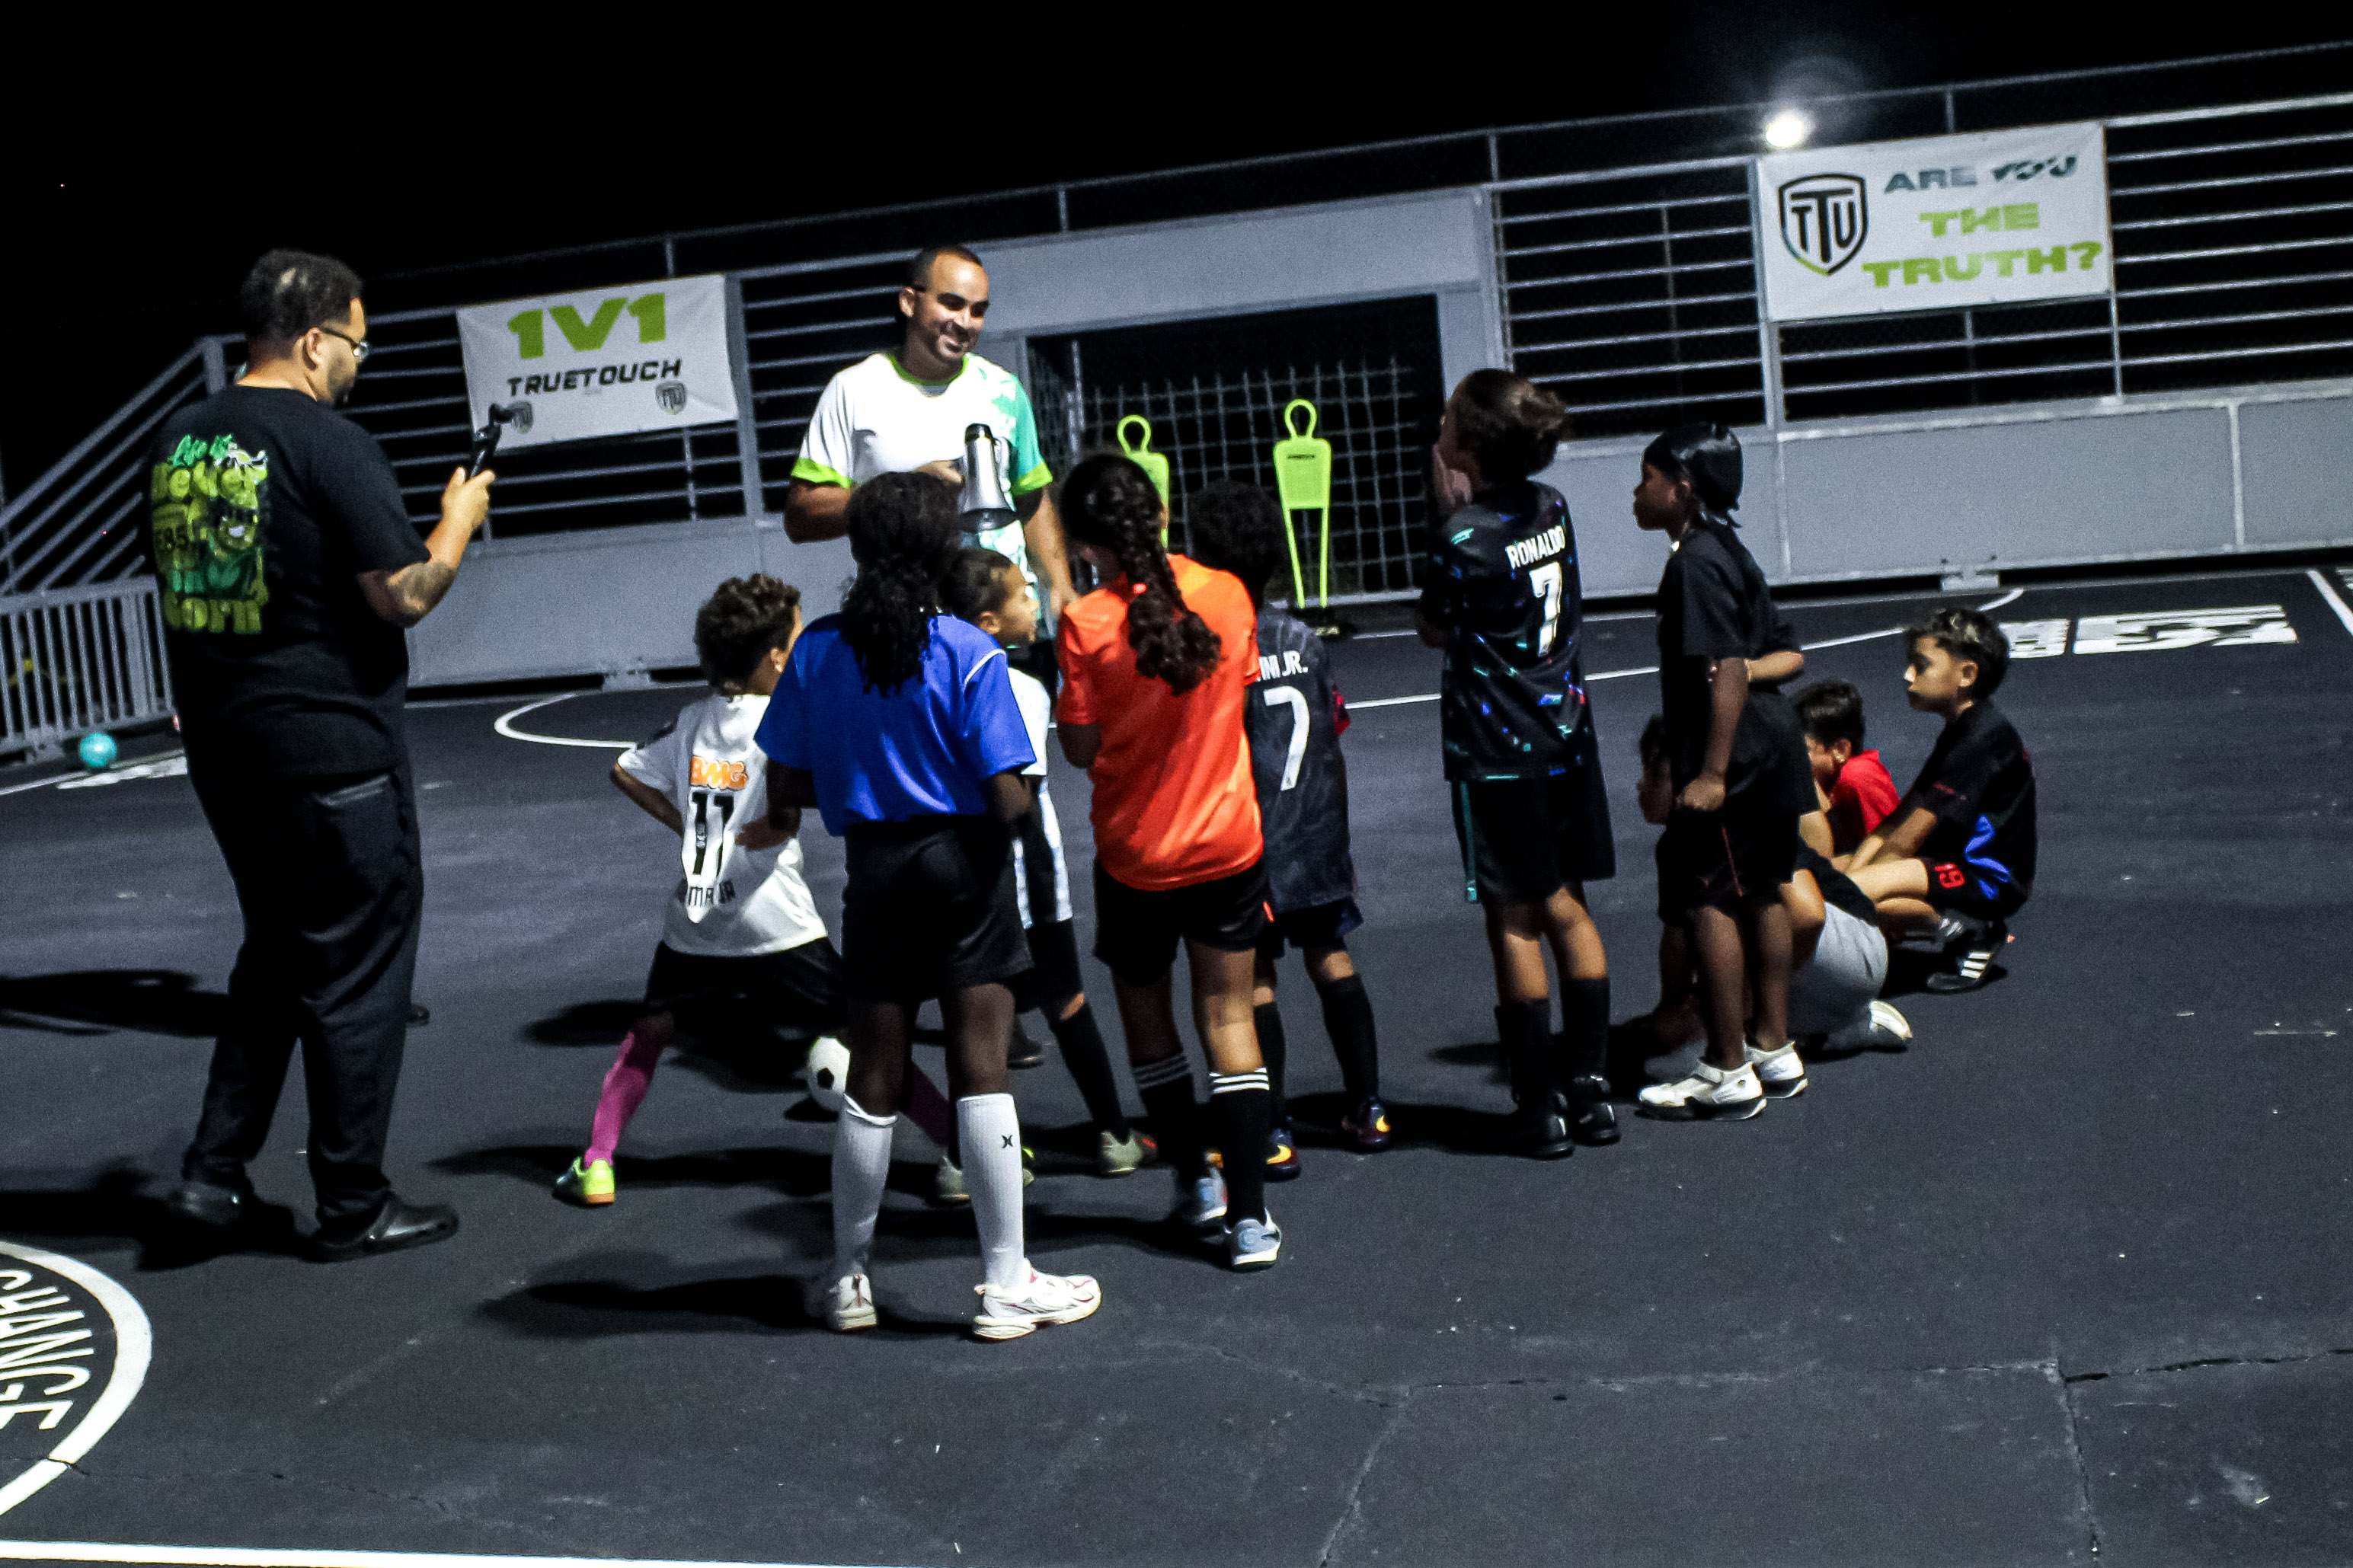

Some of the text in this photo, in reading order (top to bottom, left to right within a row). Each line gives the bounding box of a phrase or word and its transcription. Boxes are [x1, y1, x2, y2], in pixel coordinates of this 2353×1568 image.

[1884, 155, 2077, 193] ARE YOU
[1919, 203, 2039, 238] THE
[1862, 241, 2102, 289] TRUTH?
[507, 293, 666, 359] 1V1
[507, 358, 682, 397] TRUETOUCH
[1504, 525, 1565, 570] RONALDO
[1529, 561, 1562, 657] 7
[1282, 650, 1309, 677] JR.
[1263, 685, 1310, 791] 7
